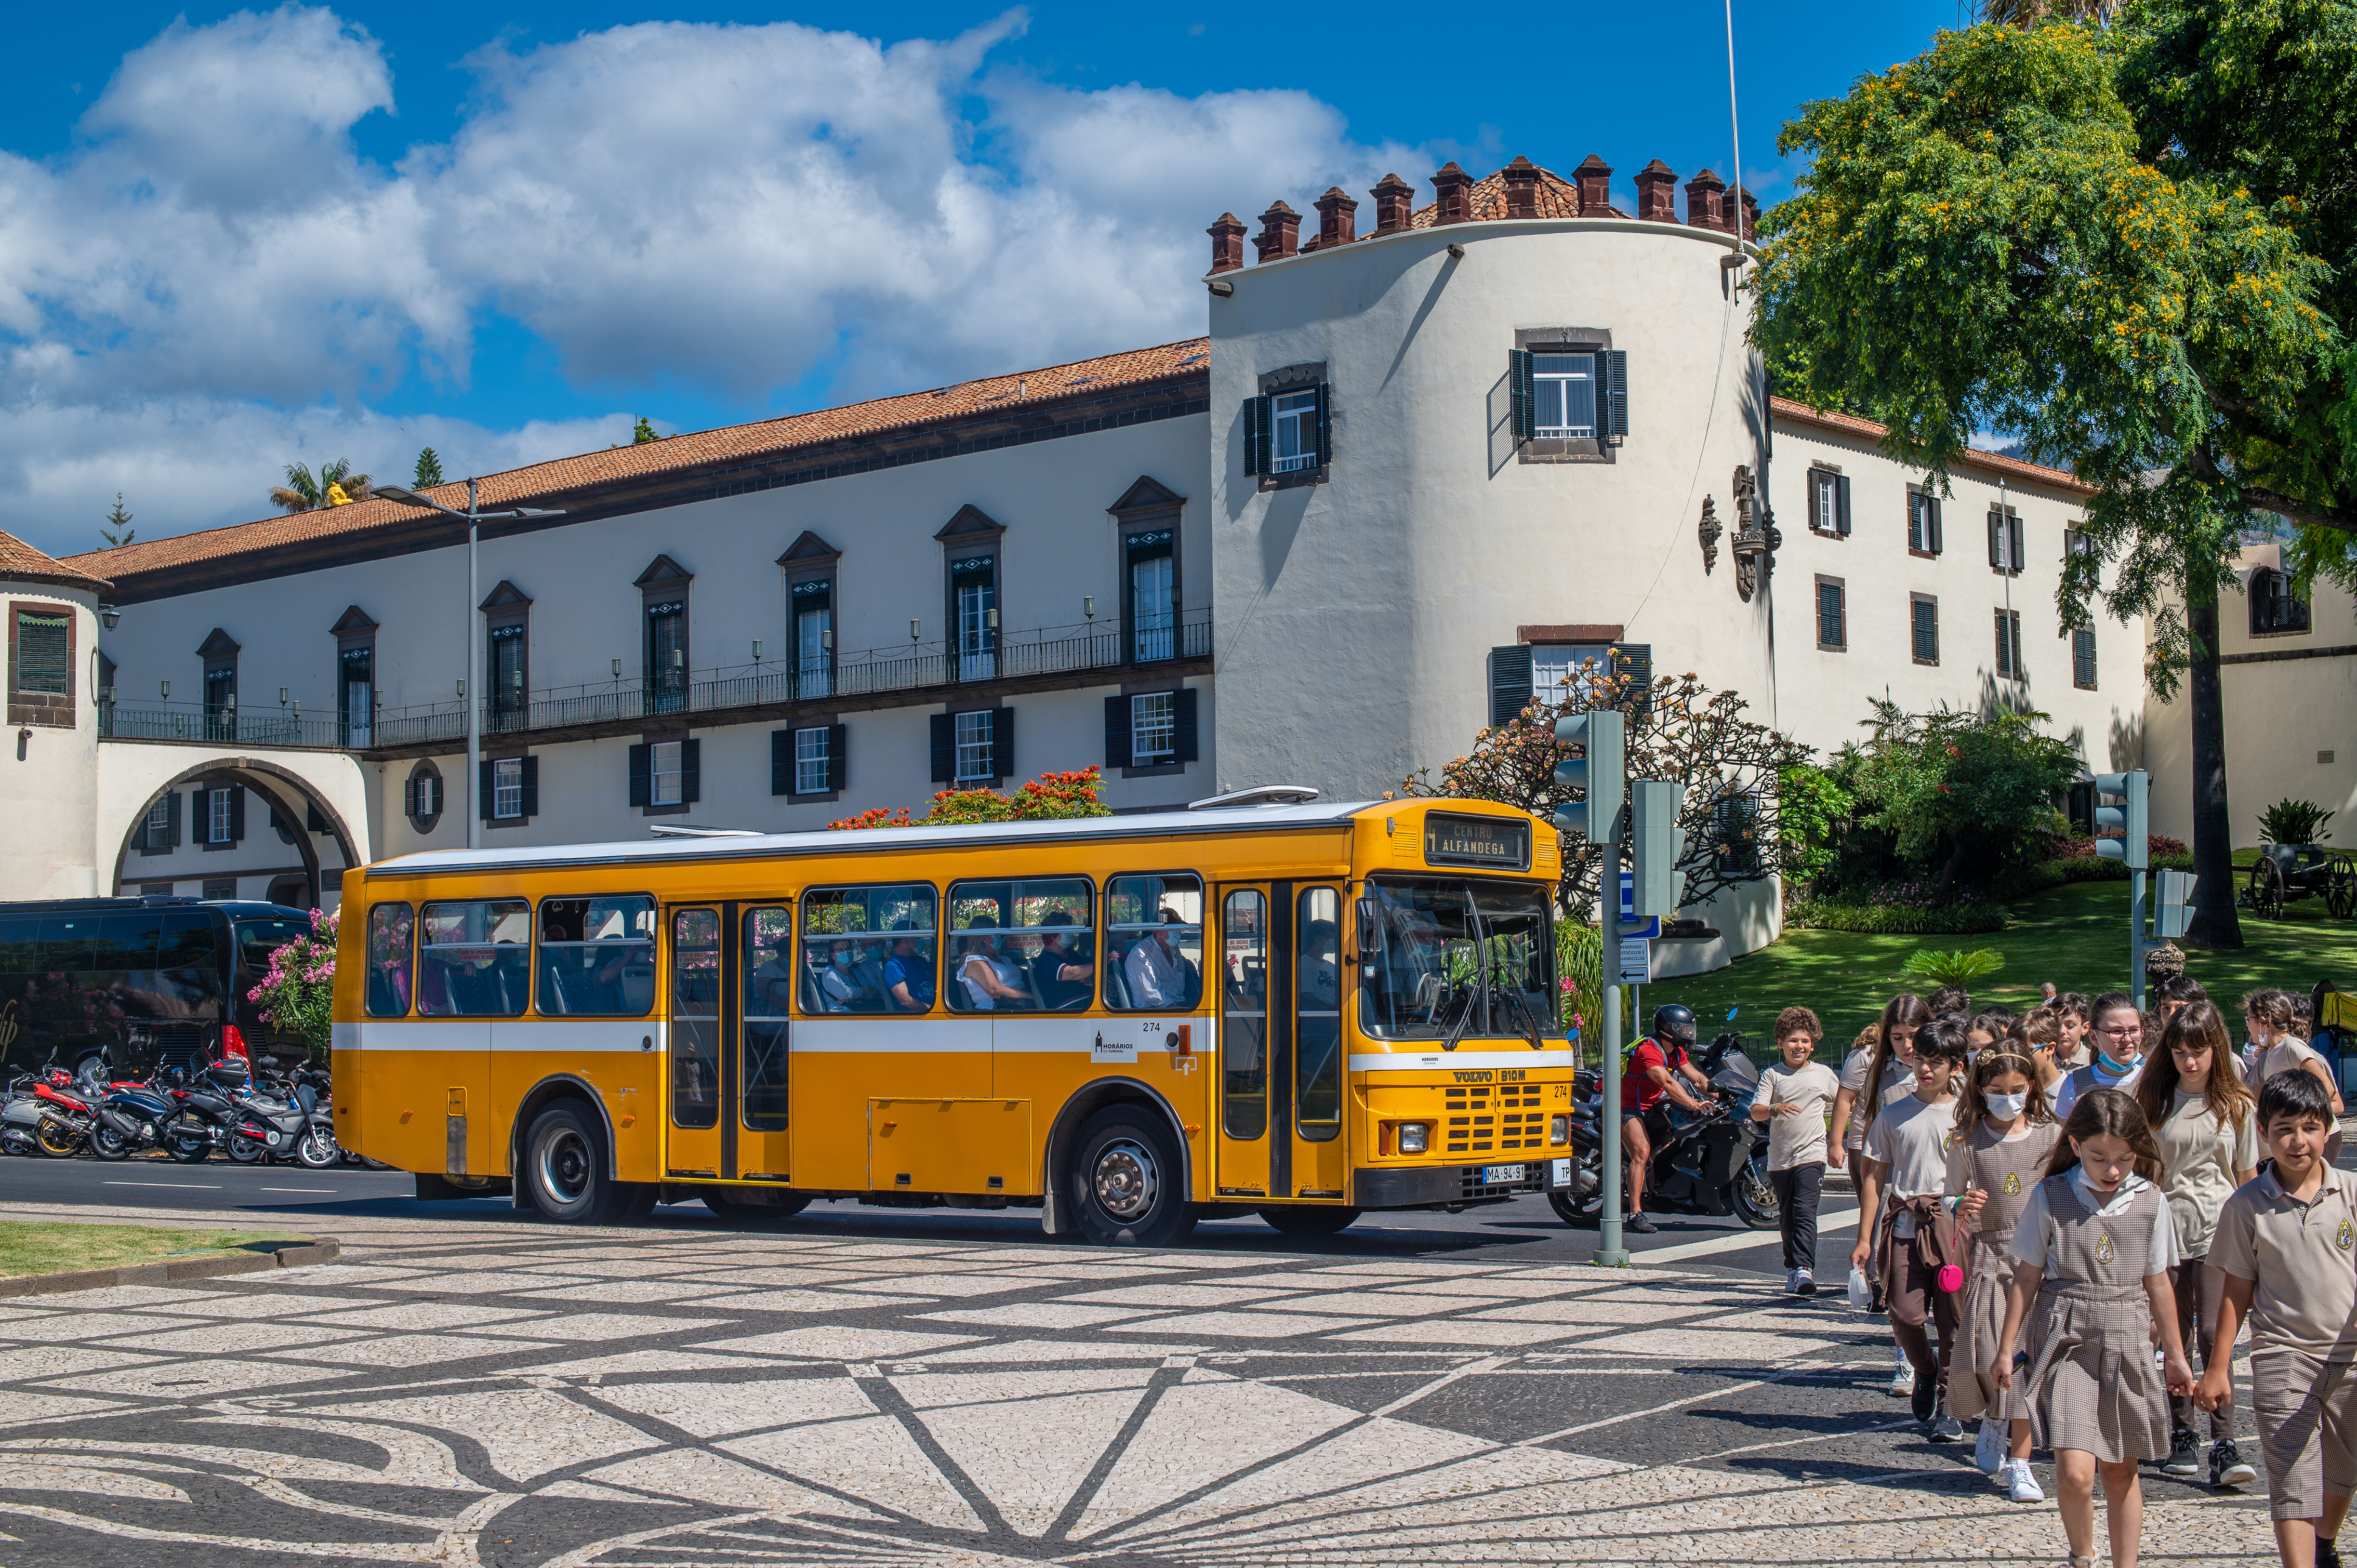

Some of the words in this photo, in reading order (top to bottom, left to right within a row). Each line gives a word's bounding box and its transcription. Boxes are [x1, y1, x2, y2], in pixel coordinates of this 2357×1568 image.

[1455, 825, 1492, 839] CENTRO
[1443, 840, 1505, 855] ALFANDEGA
[1143, 1022, 1160, 1032] 274
[1453, 1071, 1492, 1082] VOLVO
[1555, 1085, 1567, 1098] 274
[1561, 1166, 1570, 1178] TP
